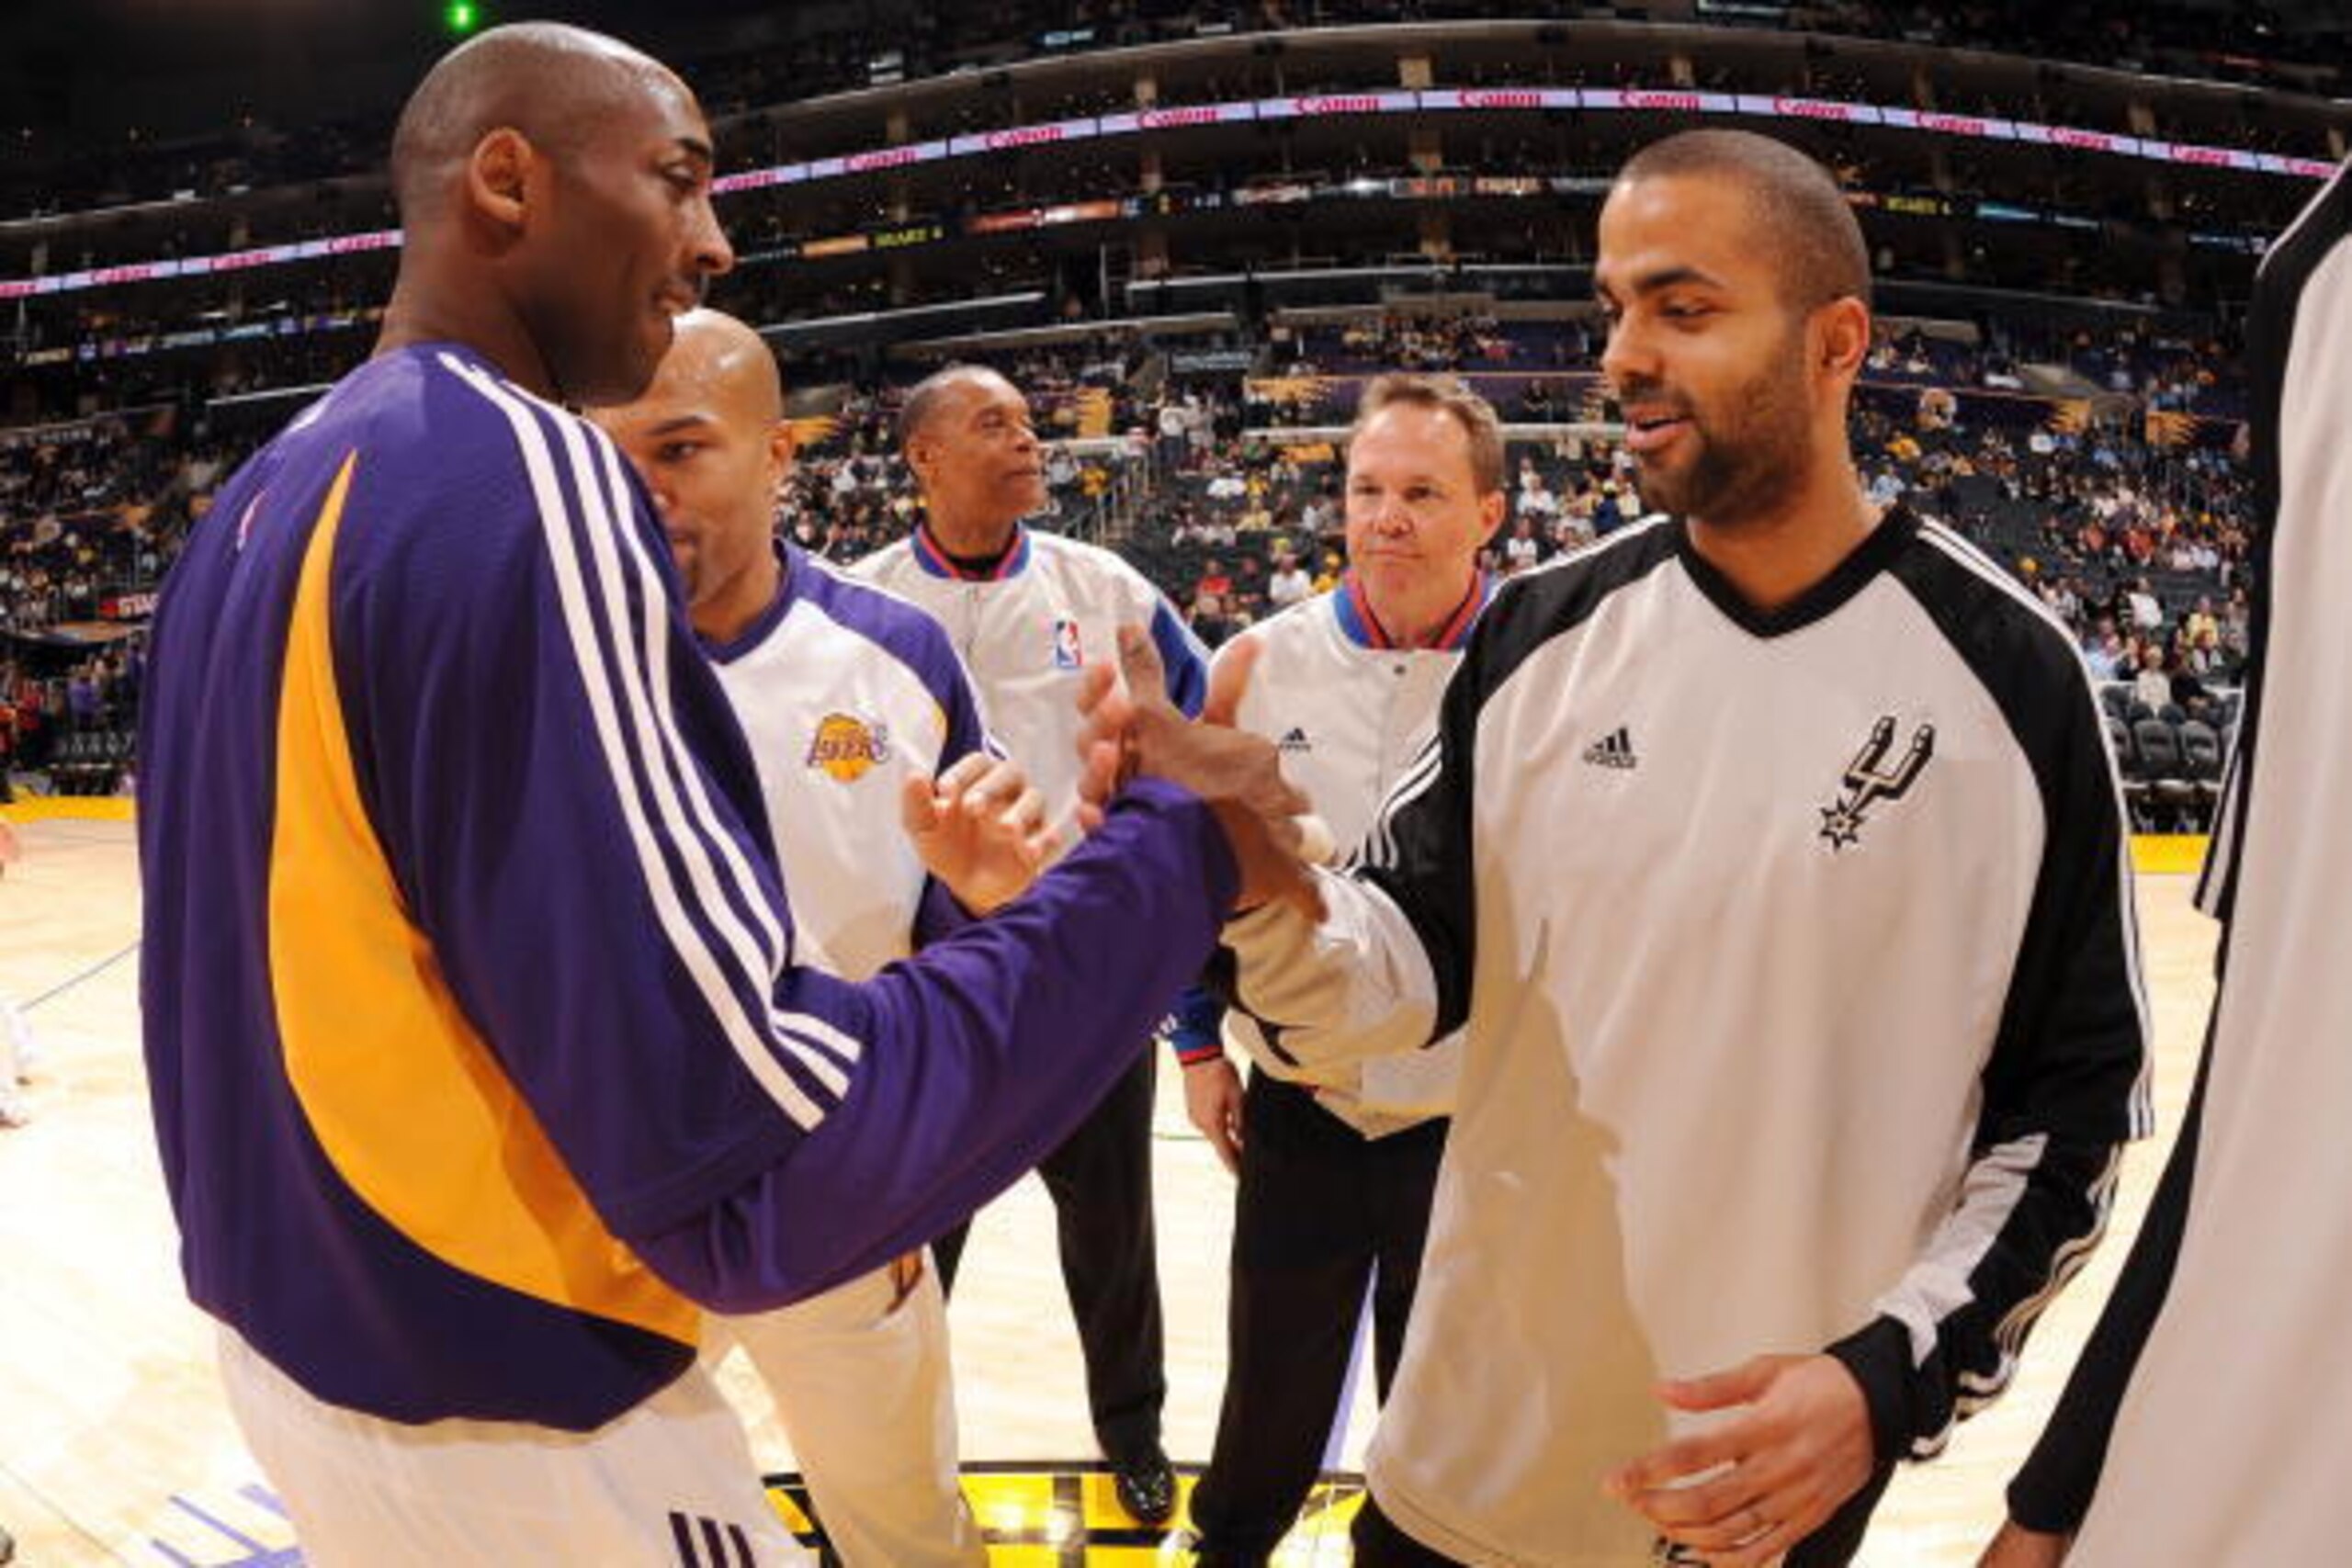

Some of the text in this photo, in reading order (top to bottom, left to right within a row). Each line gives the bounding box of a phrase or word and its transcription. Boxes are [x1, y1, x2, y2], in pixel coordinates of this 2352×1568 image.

[1295, 96, 1380, 113] Canon
[1457, 91, 1542, 107] Canon
[1620, 92, 1700, 109] Canon
[1774, 96, 1849, 119] Canon
[1137, 108, 1217, 129] Canon
